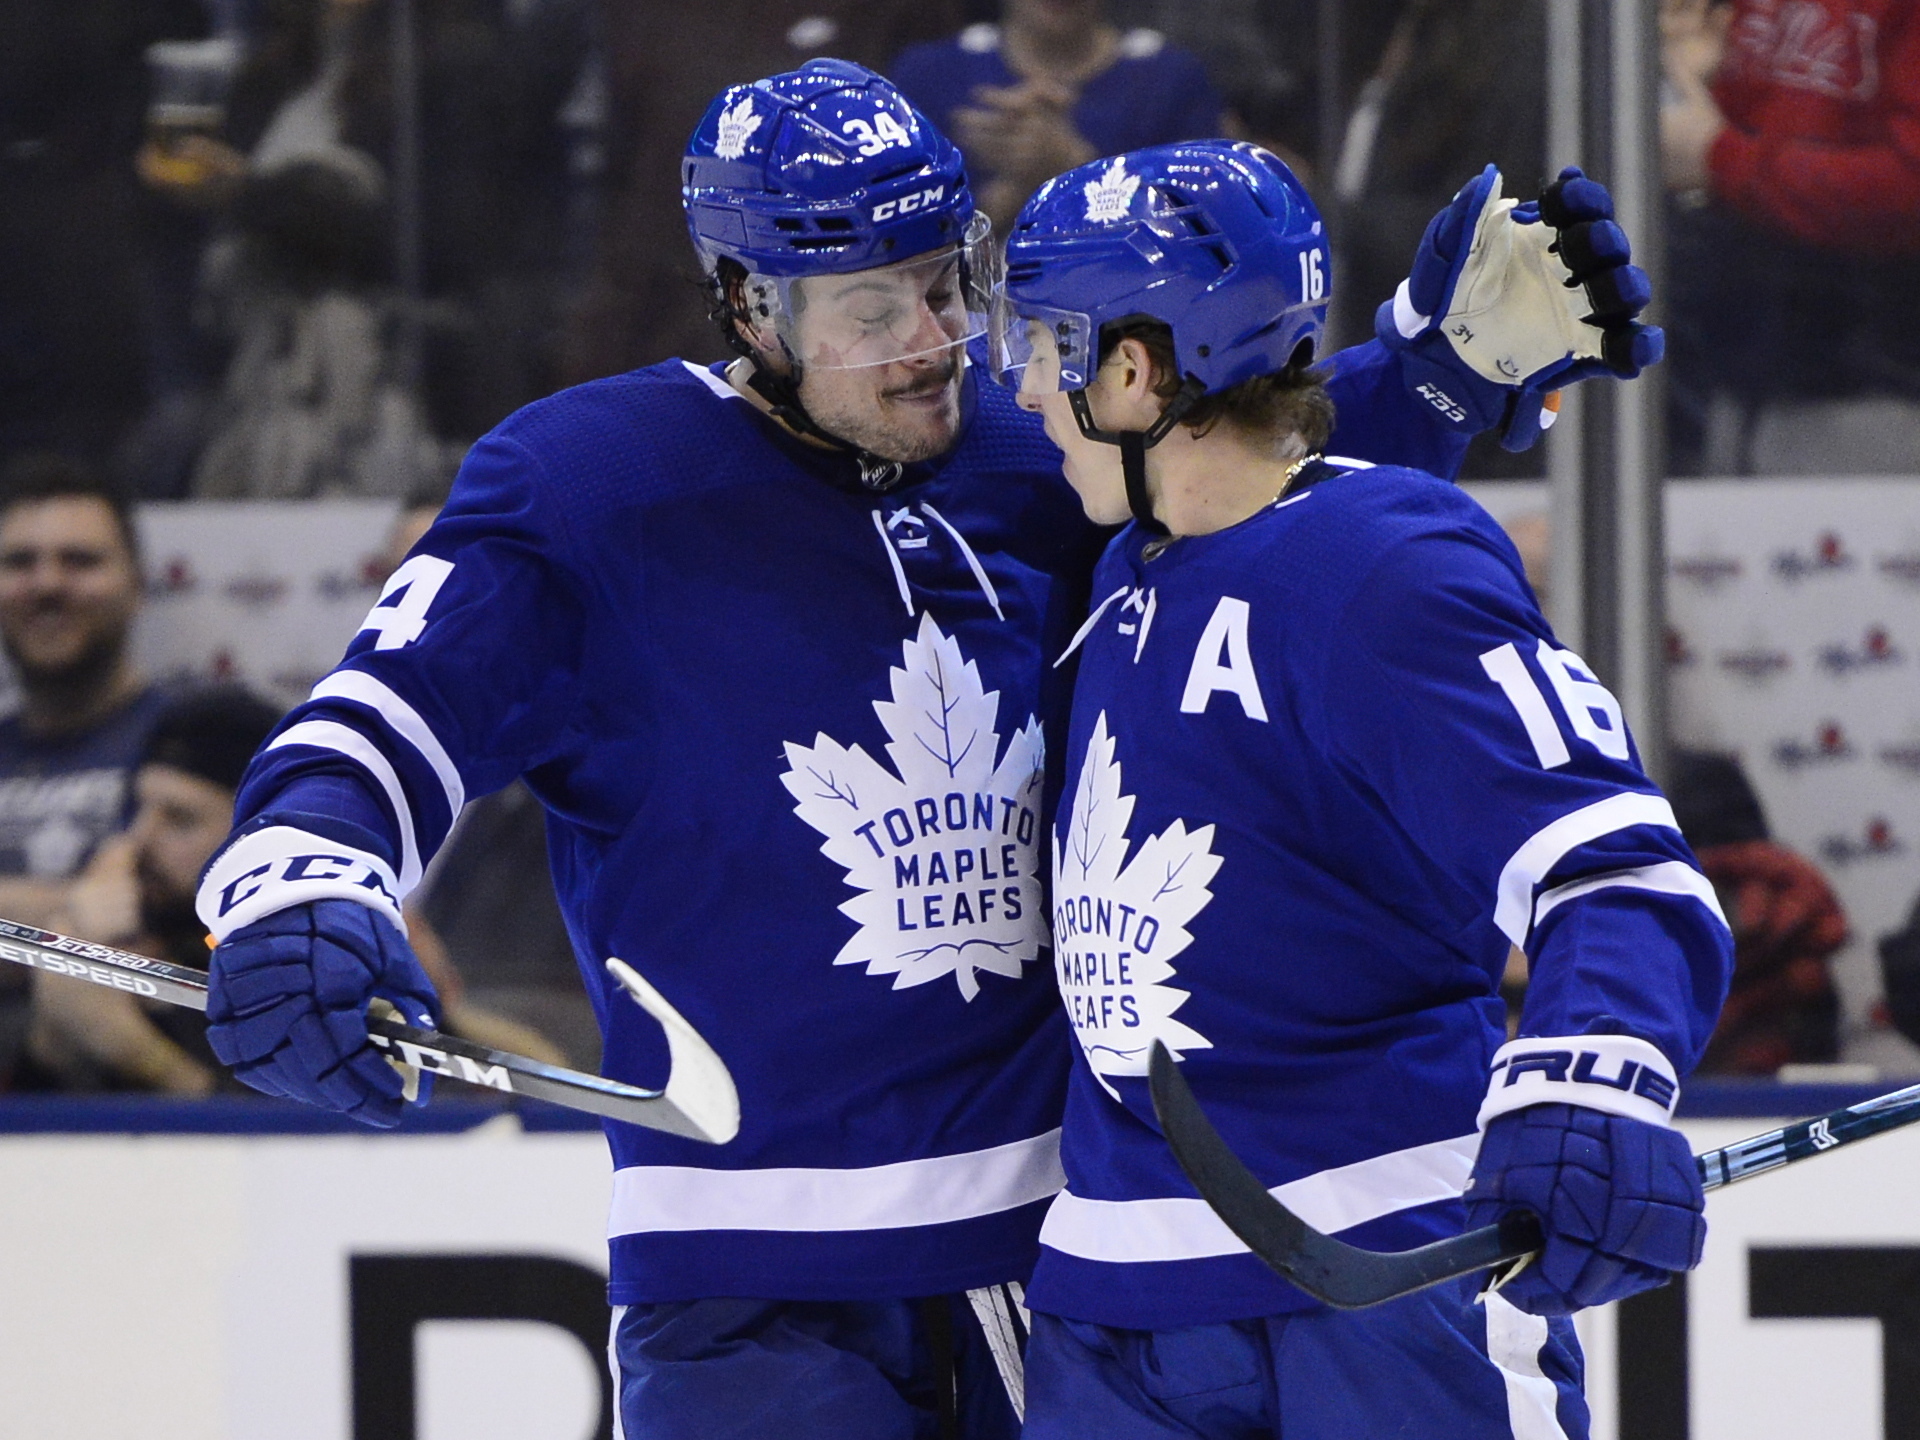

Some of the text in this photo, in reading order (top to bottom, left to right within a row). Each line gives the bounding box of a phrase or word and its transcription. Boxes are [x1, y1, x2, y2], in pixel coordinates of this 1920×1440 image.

[843, 112, 911, 156] 34
[872, 185, 944, 222] CCM
[1300, 248, 1324, 303] 16
[1451, 324, 1474, 344] 34
[1416, 385, 1465, 422] CCM
[1179, 595, 1269, 723] A
[1479, 638, 1629, 770] 16
[853, 792, 1034, 859] TORONTO
[894, 844, 1020, 889] MAPLE
[898, 886, 1023, 931] LEAFS
[42, 935, 150, 968] JETSPEED
[1062, 951, 1134, 987] MAPLE
[1490, 1049, 1677, 1112] RUE
